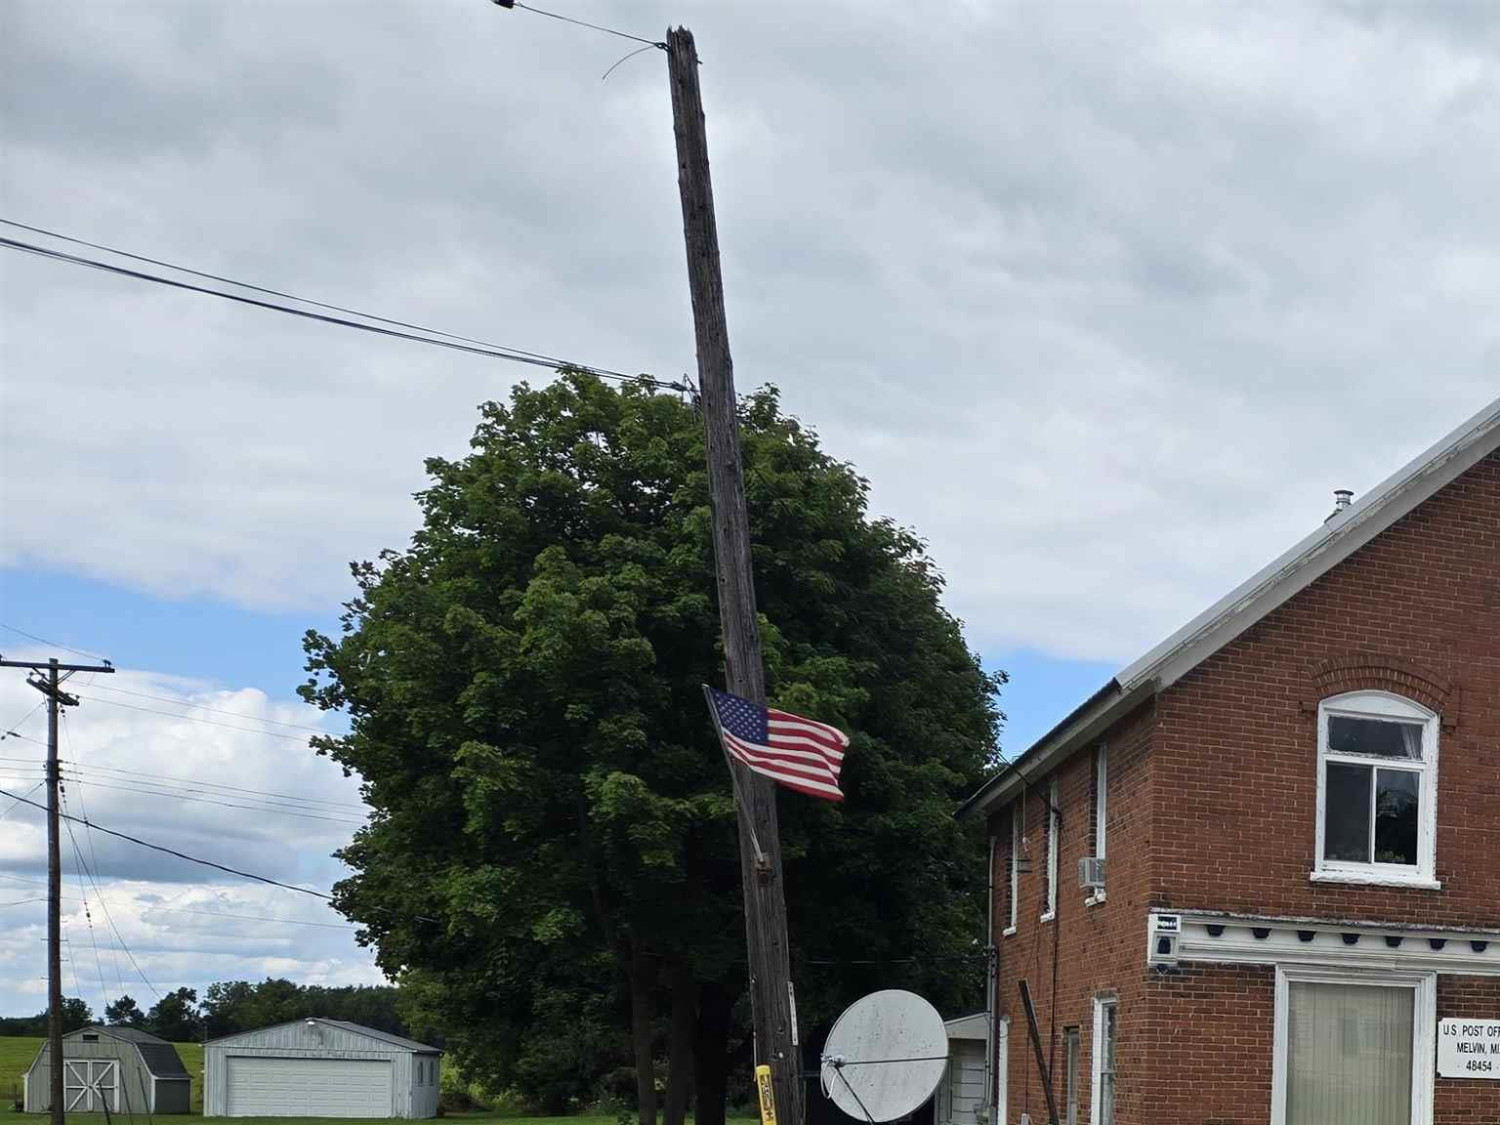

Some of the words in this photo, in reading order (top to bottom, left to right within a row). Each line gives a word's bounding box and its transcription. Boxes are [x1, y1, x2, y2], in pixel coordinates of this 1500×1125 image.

[1462, 1025, 1484, 1037] POST
[1457, 1042, 1487, 1054] MELVIN,
[1466, 1060, 1492, 1072] 48454
